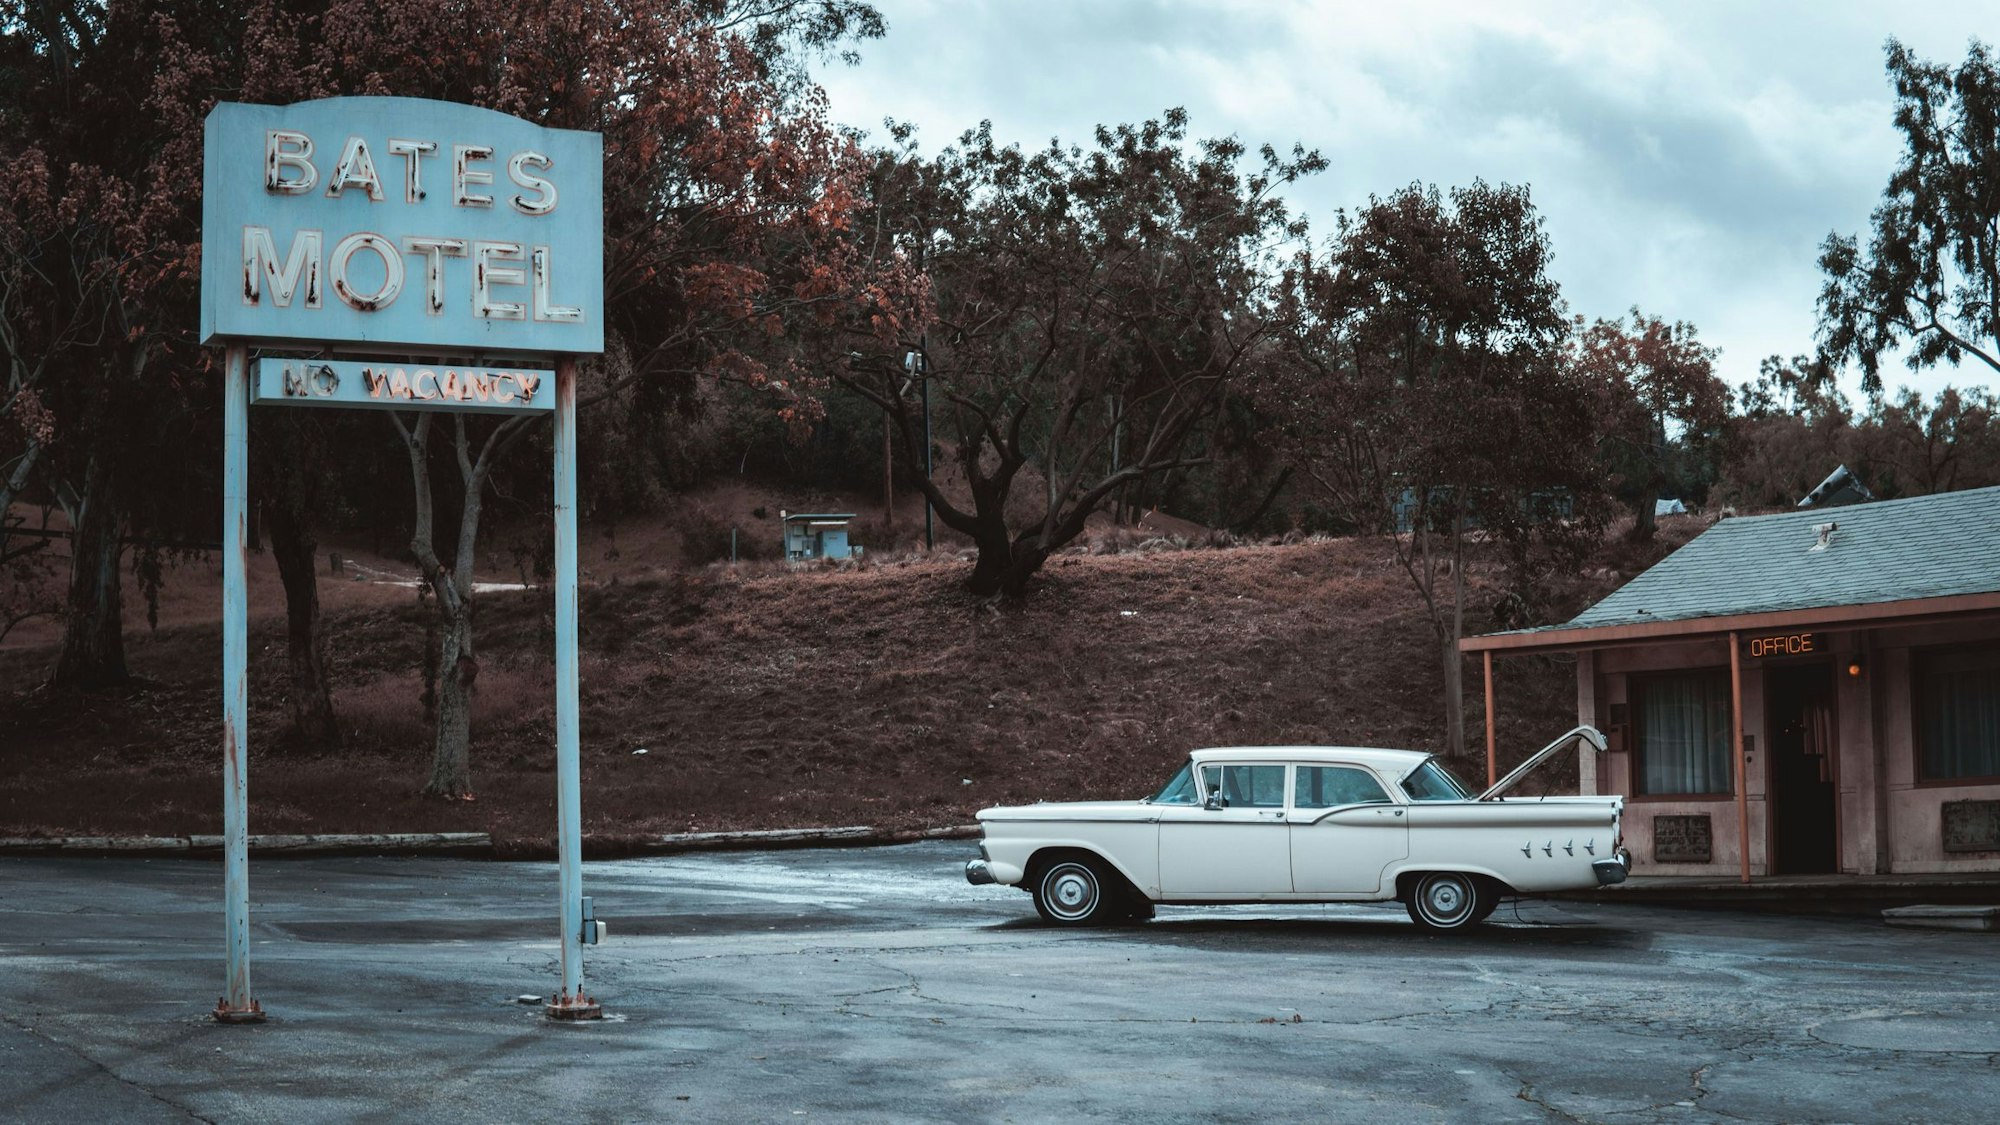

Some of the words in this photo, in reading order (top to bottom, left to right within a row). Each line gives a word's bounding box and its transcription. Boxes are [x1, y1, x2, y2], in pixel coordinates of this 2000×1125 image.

[265, 129, 558, 216] BATES
[242, 225, 585, 323] MOTEL
[283, 362, 340, 397] NO
[363, 367, 540, 404] VACANCY
[1751, 633, 1814, 657] OFFICE
